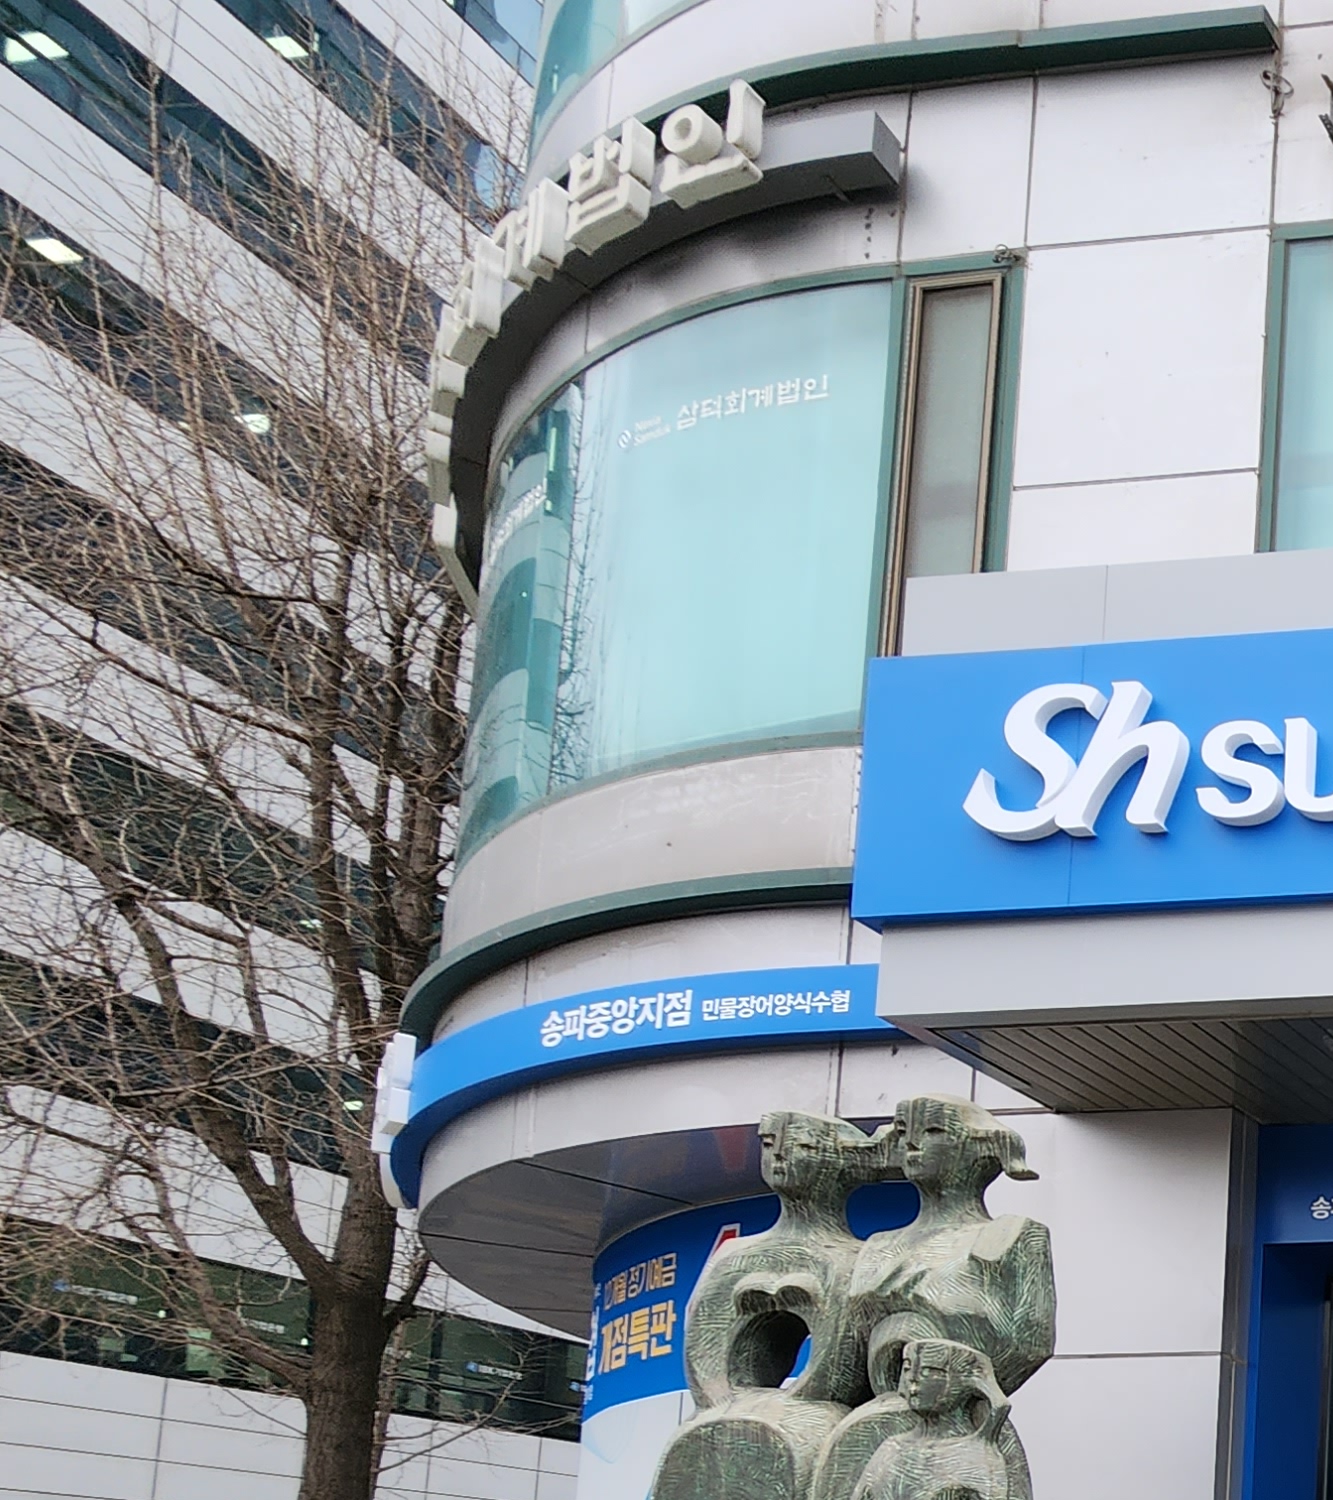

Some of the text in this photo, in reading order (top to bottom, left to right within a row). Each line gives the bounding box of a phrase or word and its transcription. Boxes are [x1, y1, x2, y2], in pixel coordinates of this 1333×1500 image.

[676, 374, 832, 431] 삼덕회계법인
[963, 680, 1190, 842] Sh
[540, 989, 851, 1048] 송파중앙지점 민물장어양식수협
